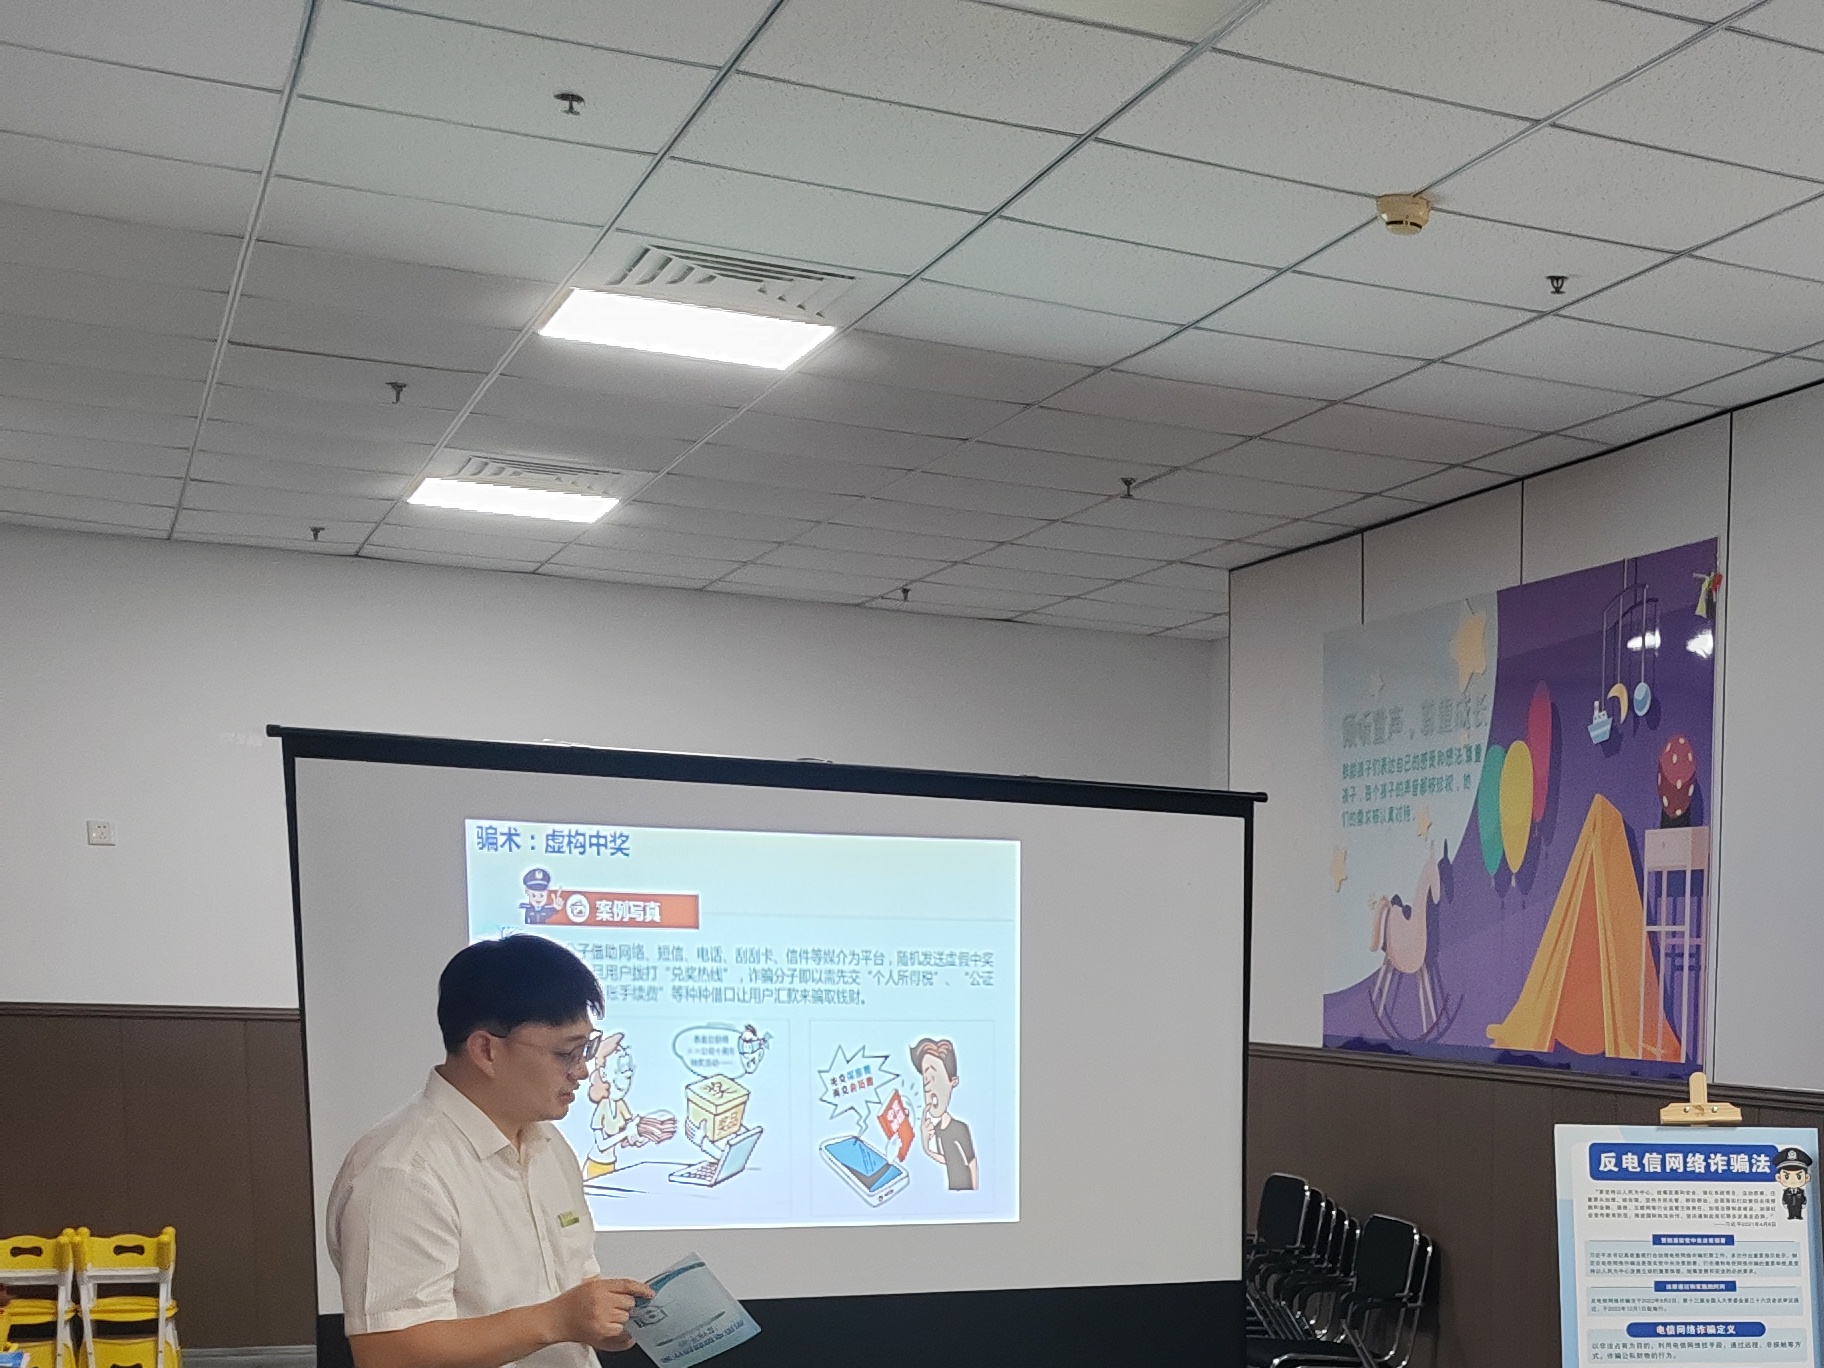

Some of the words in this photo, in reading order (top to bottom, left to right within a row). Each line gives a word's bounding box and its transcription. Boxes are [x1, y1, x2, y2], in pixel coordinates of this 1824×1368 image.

[476, 825, 630, 857] 骗术：虚构中奖
[596, 900, 661, 922] 案例写真
[1599, 1152, 1771, 1173] 反电信网络诈骗法
[1656, 1324, 1736, 1335] 电信网络诈骗定义
